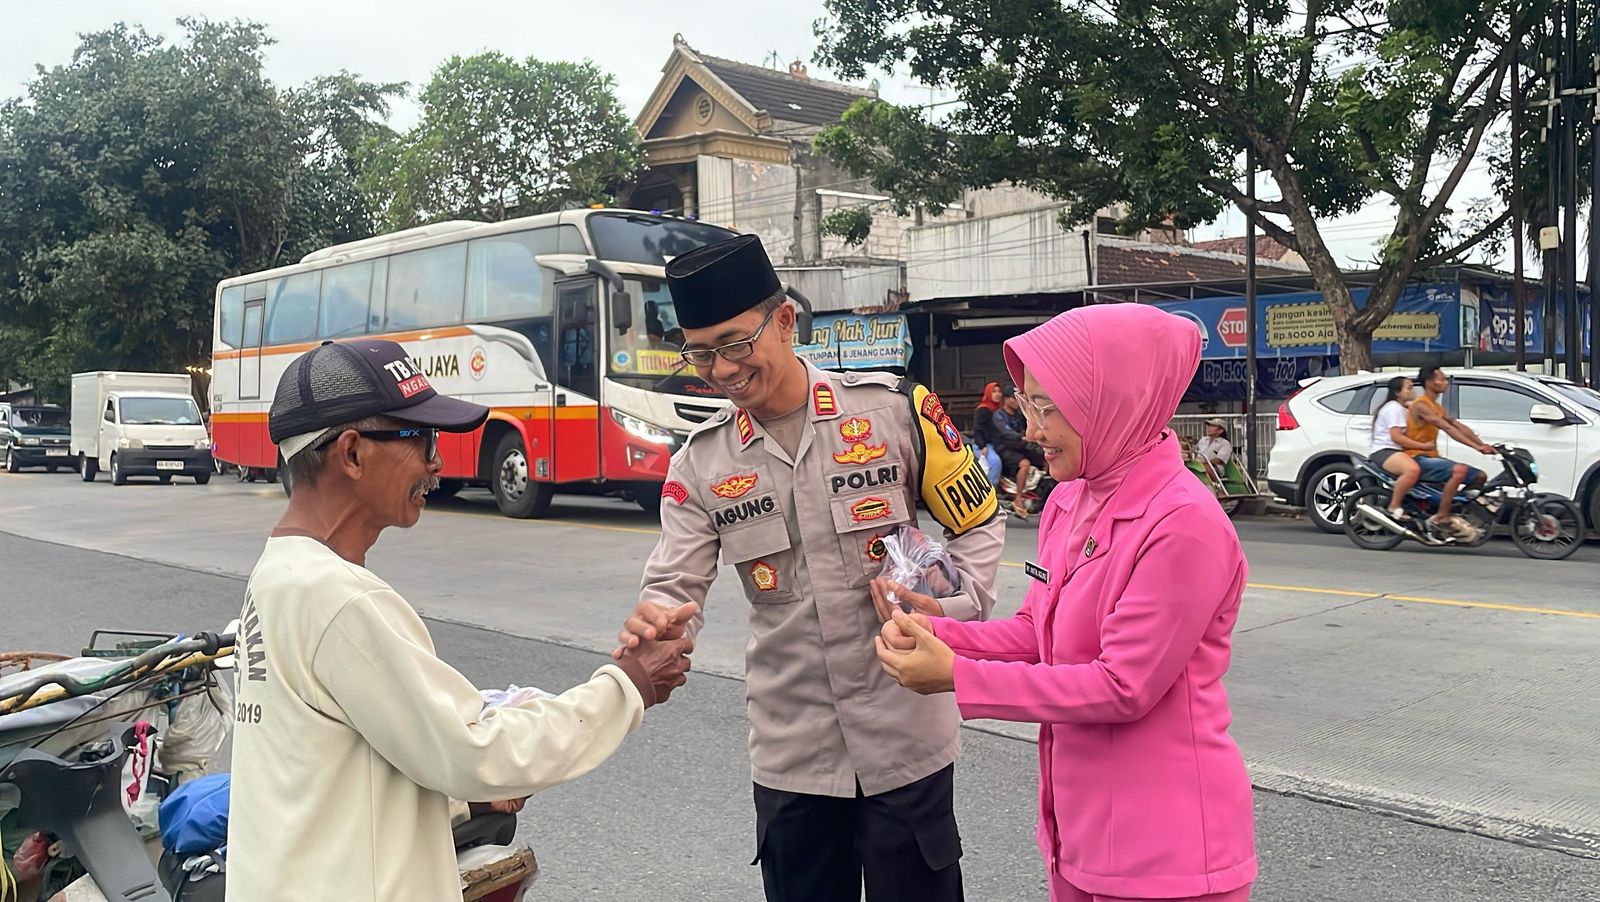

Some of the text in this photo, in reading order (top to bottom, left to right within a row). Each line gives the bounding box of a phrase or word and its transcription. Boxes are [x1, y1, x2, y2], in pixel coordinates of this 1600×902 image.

[1307, 307, 1331, 318] kesin
[1273, 329, 1334, 341] Rp.5000 Aja
[425, 354, 460, 377] JAYA
[1203, 361, 1258, 386] Rp 5.00
[831, 465, 898, 494] POLRI
[714, 495, 775, 527] AGUNG
[236, 702, 262, 724] 2019
